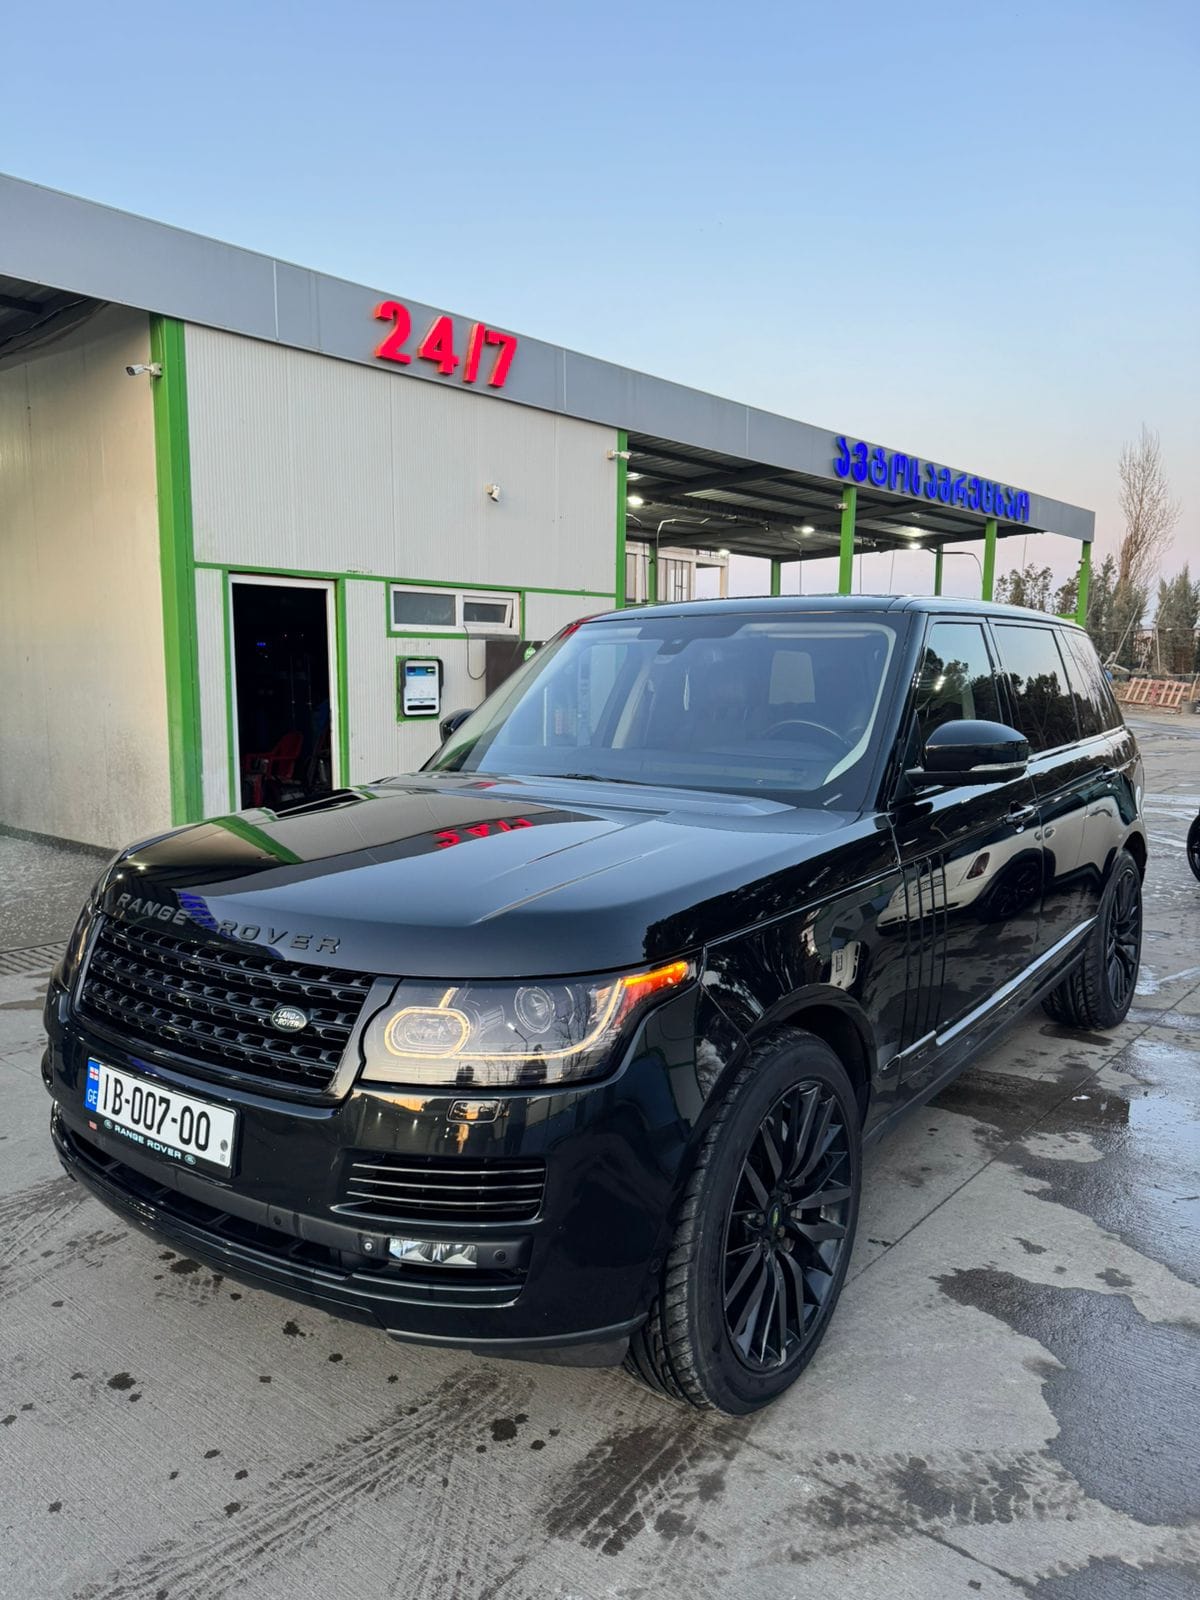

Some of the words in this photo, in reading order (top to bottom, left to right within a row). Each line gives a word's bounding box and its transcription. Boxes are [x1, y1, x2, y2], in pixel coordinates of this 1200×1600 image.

[374, 300, 518, 388] 24/7
[833, 435, 1031, 523] ავტოსამრეცხაო
[116, 893, 190, 926] RANGE
[217, 919, 341, 954] ROVER
[87, 1088, 98, 1105] GE
[114, 1124, 145, 1145] RANGE
[146, 1139, 182, 1160] ROVER
